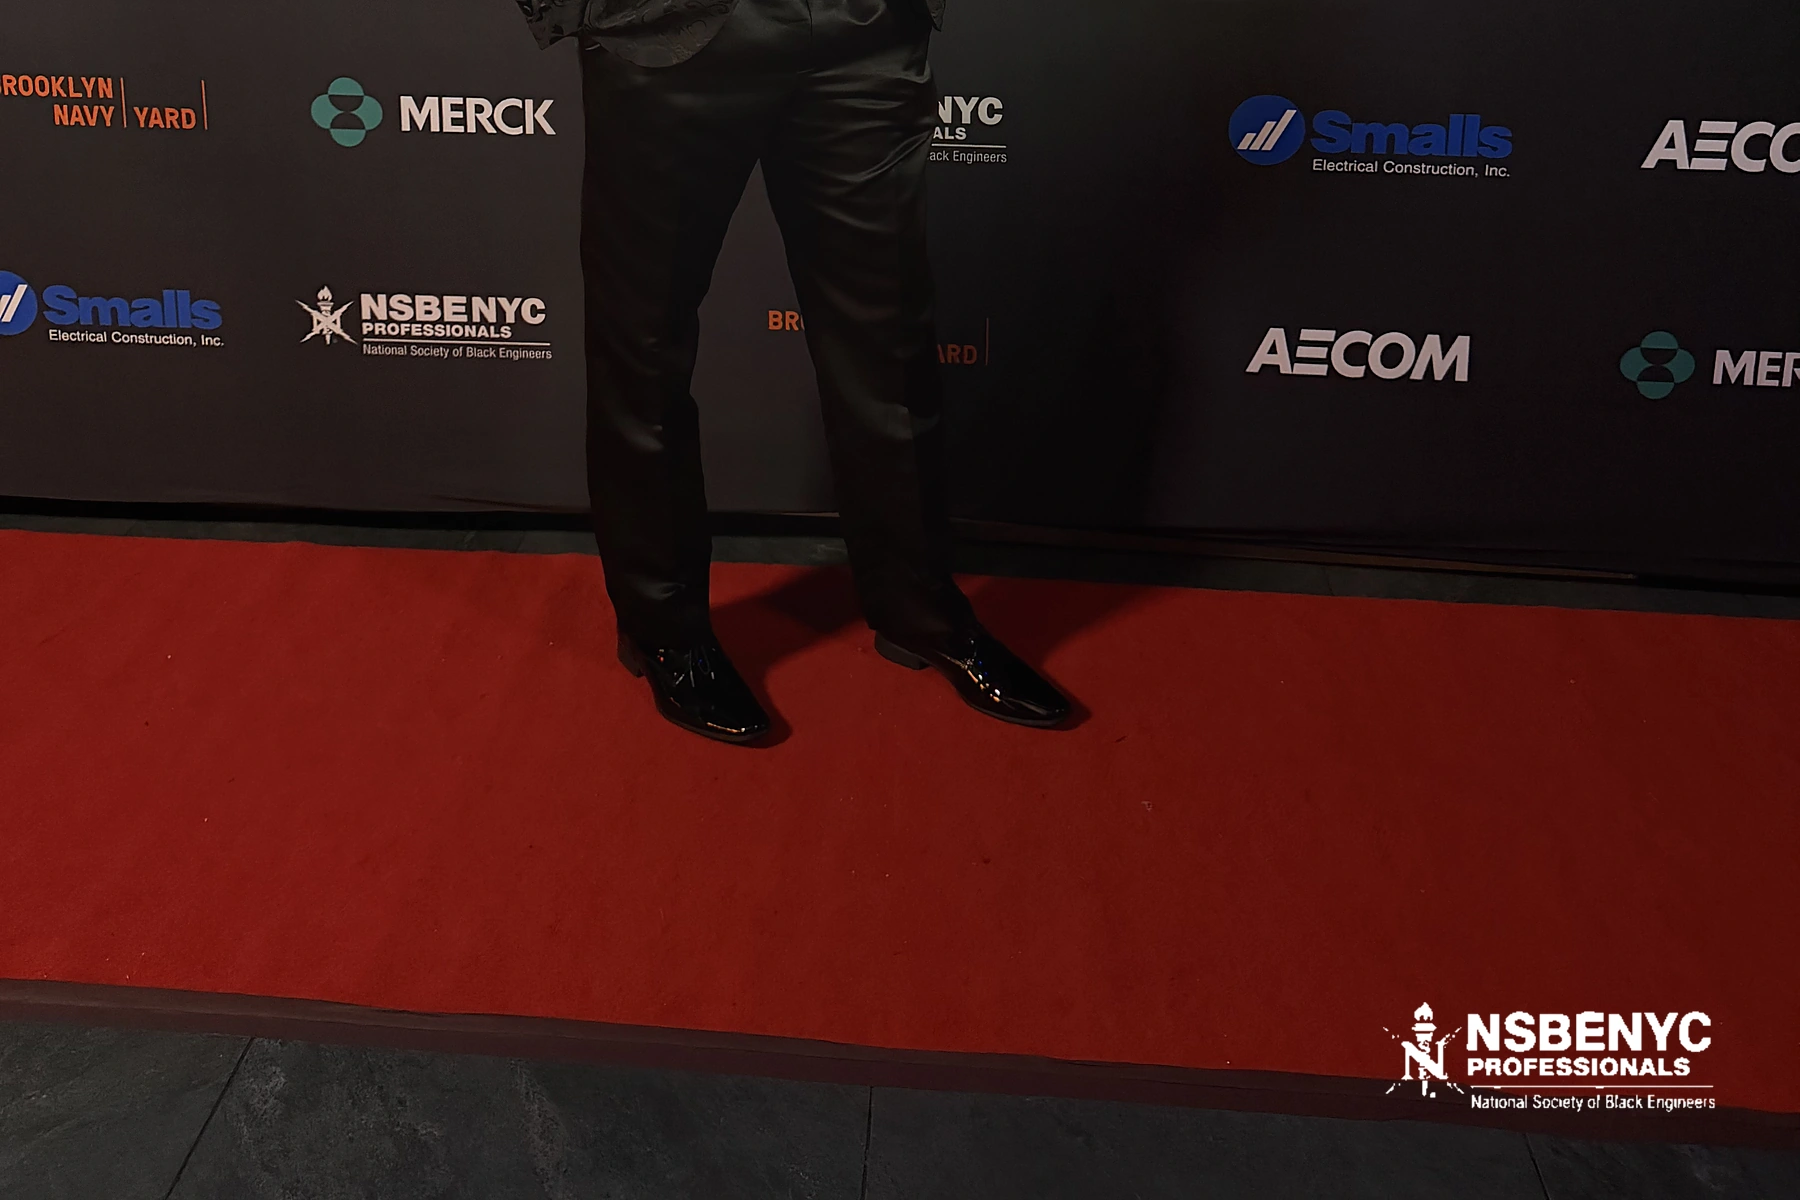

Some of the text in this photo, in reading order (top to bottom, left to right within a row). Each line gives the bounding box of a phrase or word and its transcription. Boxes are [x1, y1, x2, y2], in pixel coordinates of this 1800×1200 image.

[0, 74, 113, 99] ROOKLYN
[53, 104, 197, 130] NAVY YARD
[400, 95, 556, 135] MERCK
[1310, 109, 1513, 159] Smalls
[953, 150, 1008, 165] Engineers
[1312, 158, 1511, 178] Electrical Construction, Inc.
[43, 284, 223, 329] Smalls
[49, 328, 225, 348] Electrical Construction, Inc.
[361, 323, 512, 339] PROFESSIONALS
[362, 343, 552, 361] National Society of Black Engineers
[1246, 327, 1471, 382] AECOM
